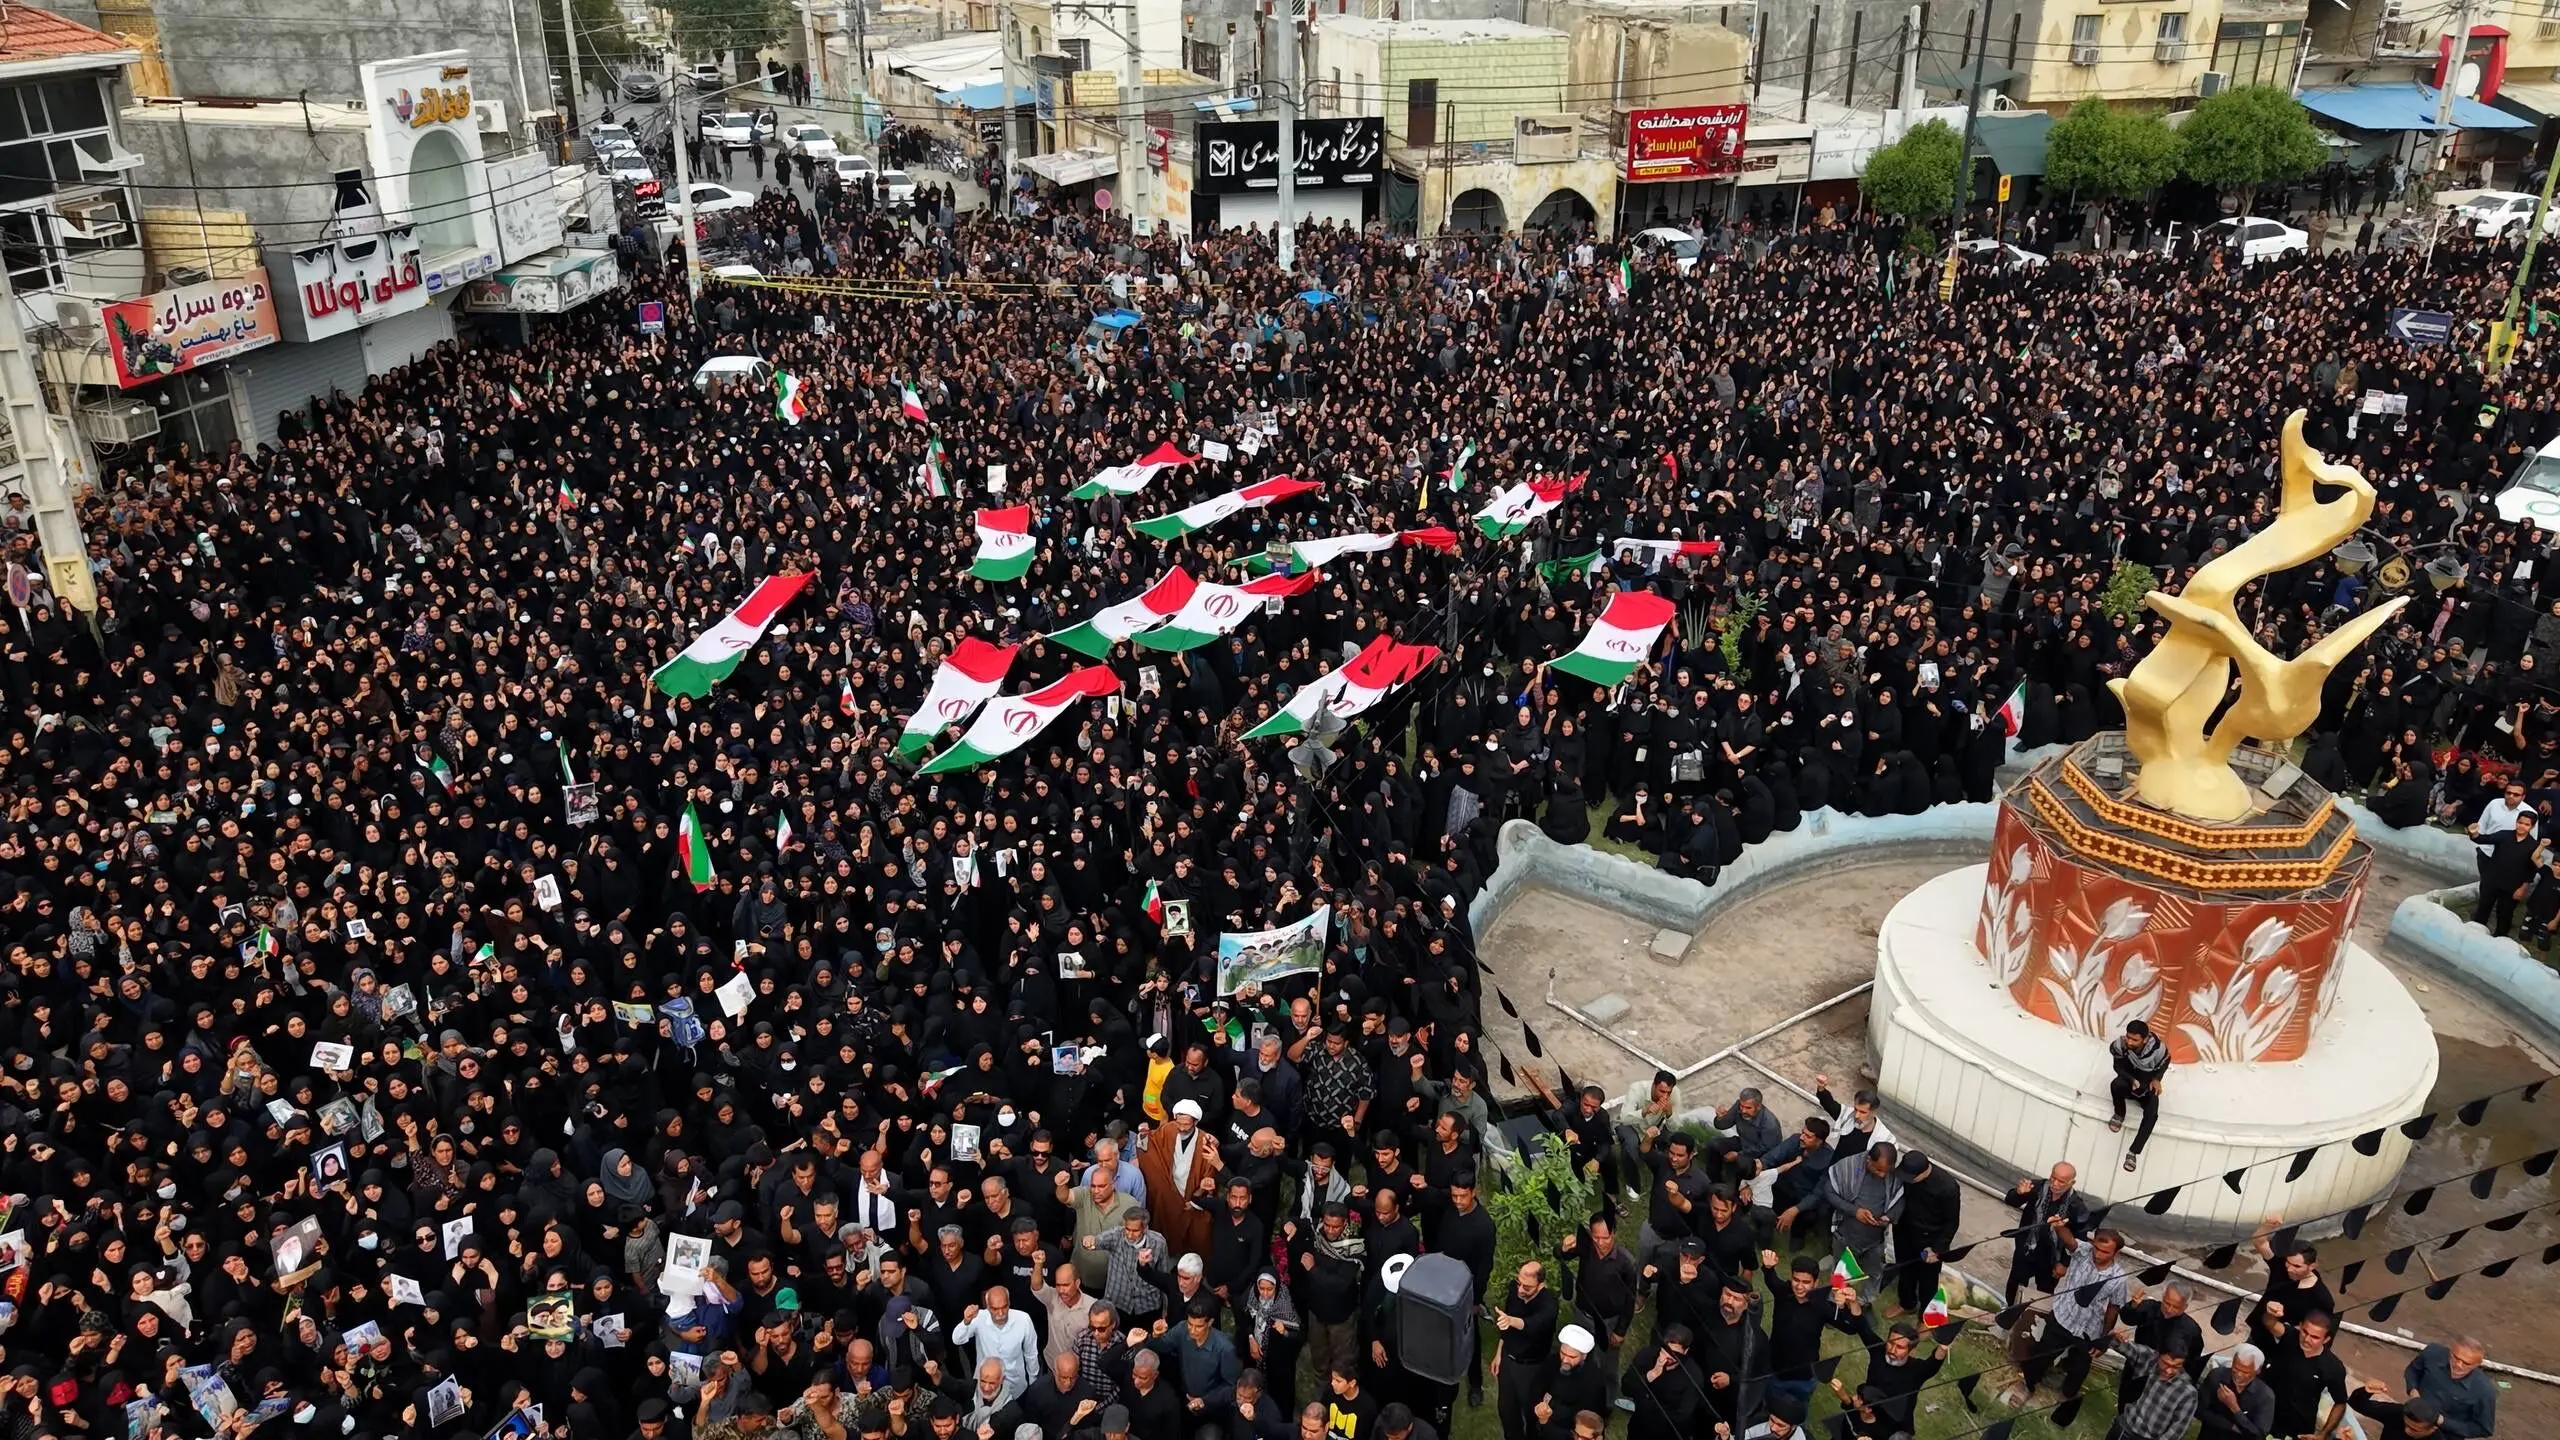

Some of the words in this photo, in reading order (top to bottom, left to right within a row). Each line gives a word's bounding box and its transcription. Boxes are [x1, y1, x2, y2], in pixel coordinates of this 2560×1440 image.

[1637, 112, 1696, 130] بهداشتی
[1697, 109, 1744, 127] آرایشی
[1293, 129, 1330, 171] موبایل
[1330, 120, 1379, 168] فروشگاه
[374, 249, 423, 303] آقای
[221, 282, 265, 311] میوه
[305, 269, 370, 318] نوتلا
[179, 325, 231, 349] بهشت
[233, 313, 257, 340] باغ
